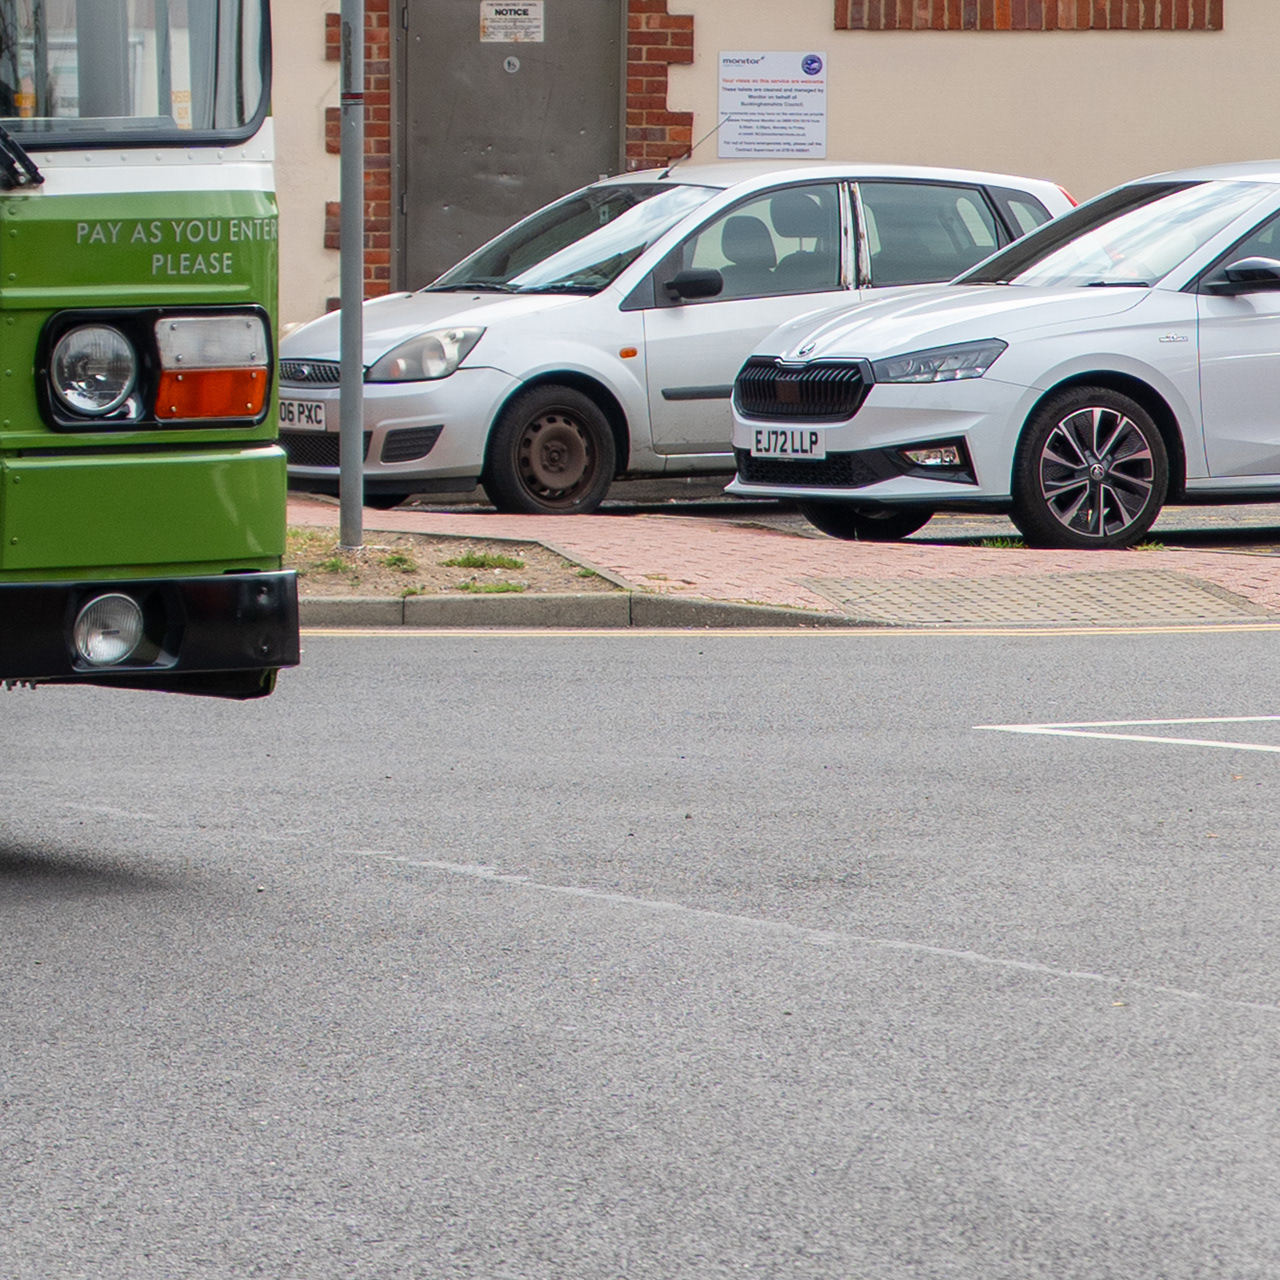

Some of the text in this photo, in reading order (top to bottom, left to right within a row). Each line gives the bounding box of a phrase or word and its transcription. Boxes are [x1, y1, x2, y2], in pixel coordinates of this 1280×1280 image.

[494, 8, 529, 16] NOTICE
[722, 57, 761, 65] monitor
[77, 219, 278, 244] PAY AS YOU ENTER
[152, 252, 232, 275] PLEASE
[297, 403, 322, 424] PXC
[755, 430, 818, 454] EJ72 LLP
